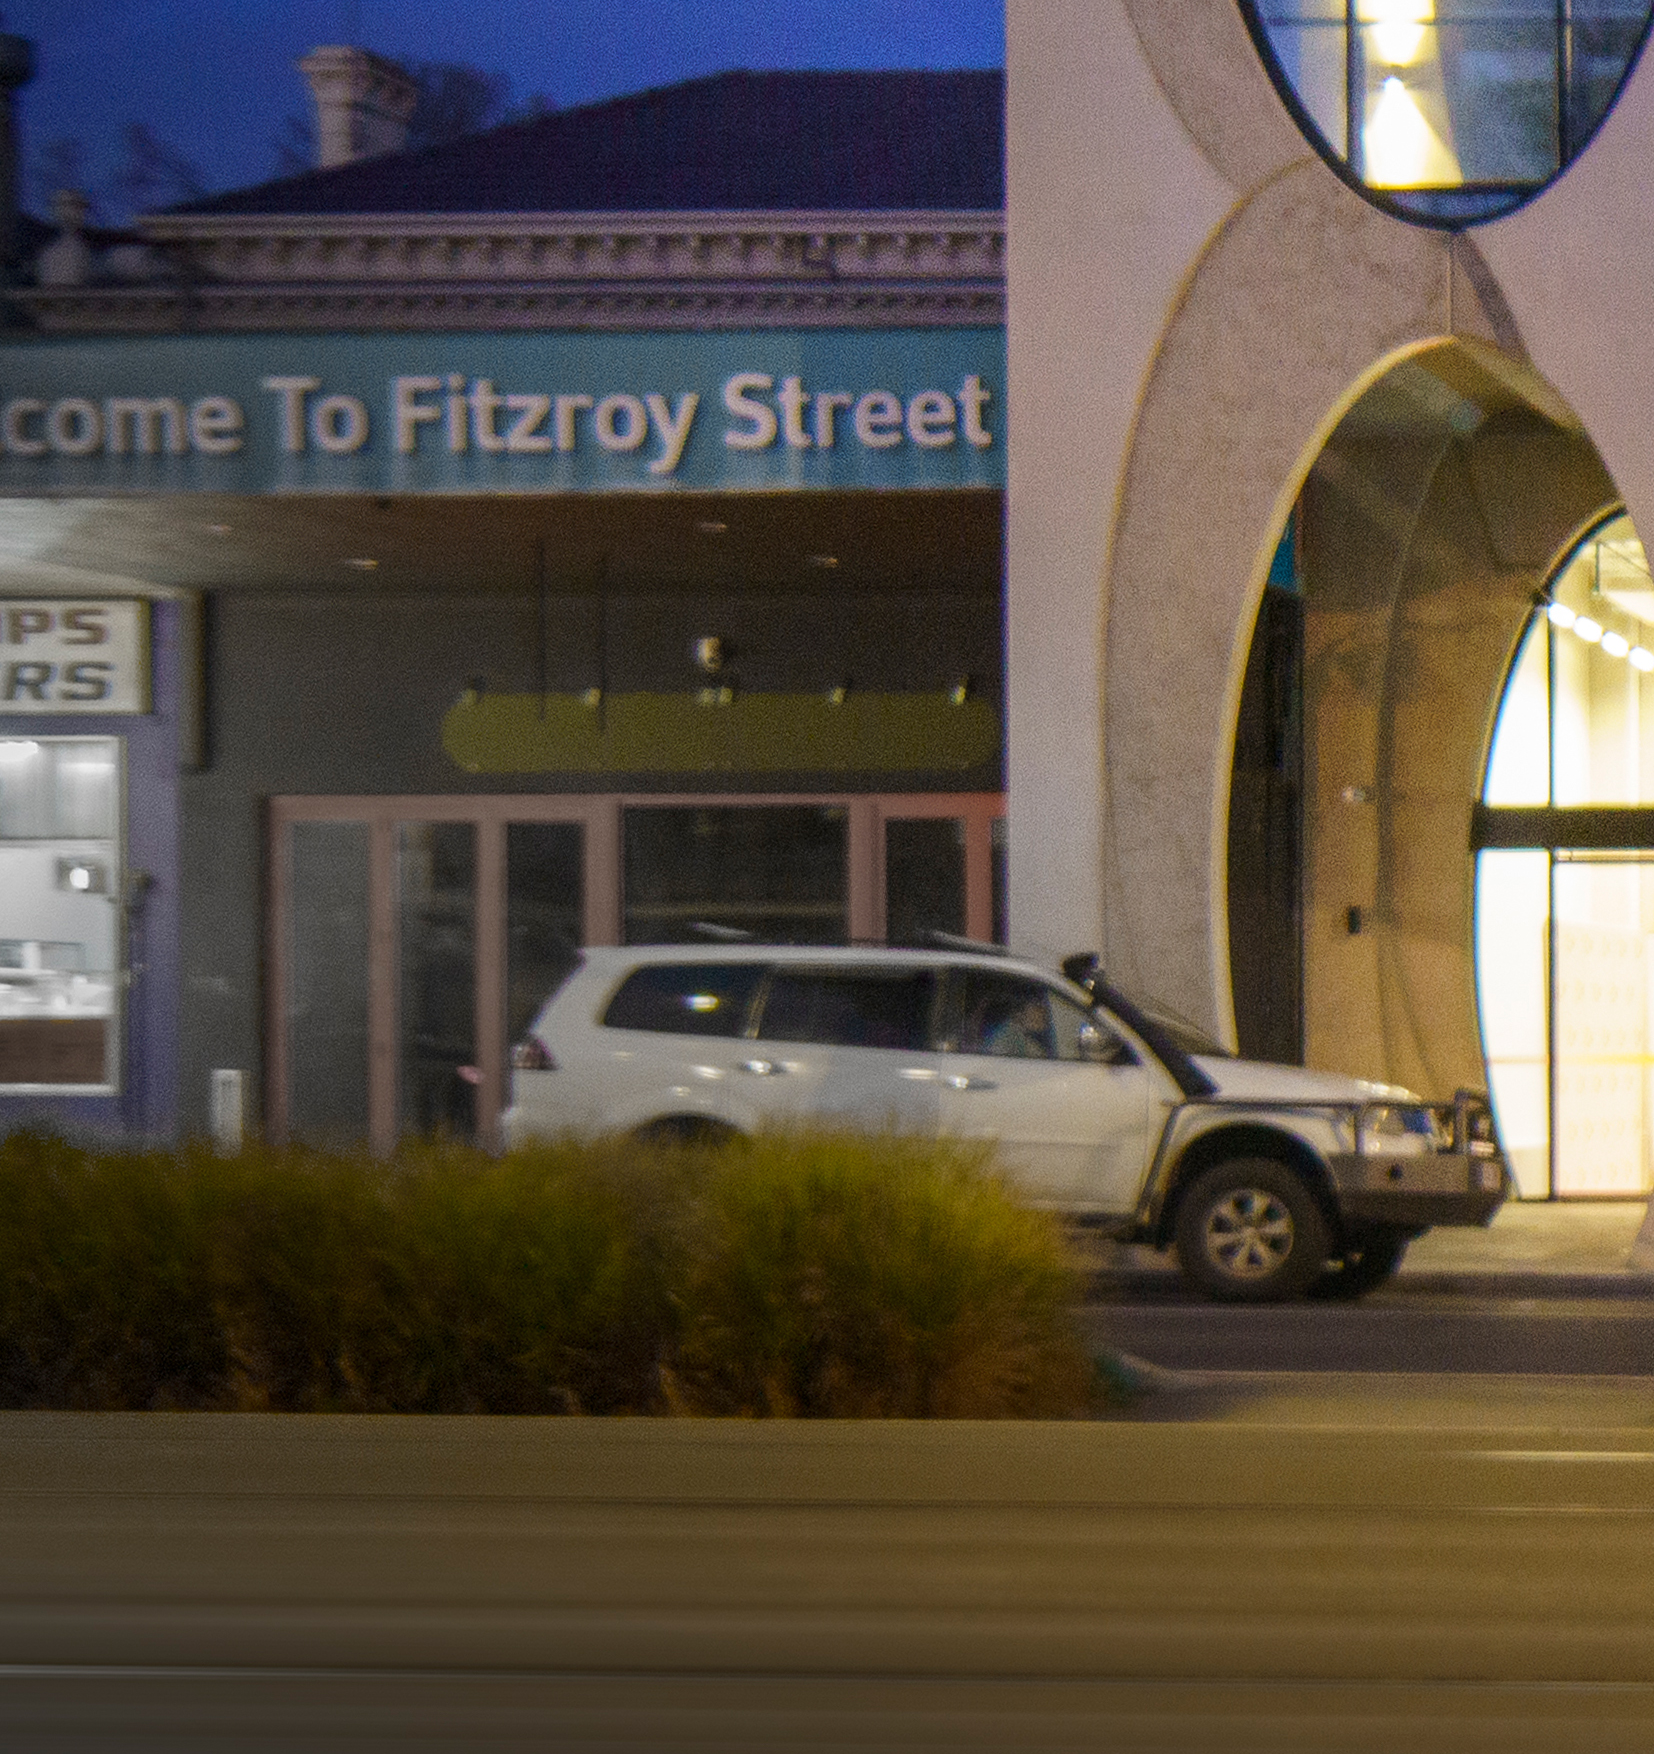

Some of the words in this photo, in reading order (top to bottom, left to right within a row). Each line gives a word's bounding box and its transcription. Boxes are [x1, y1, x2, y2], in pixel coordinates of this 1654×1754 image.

[2, 396, 245, 455] come
[259, 374, 369, 455] To
[394, 372, 699, 475] Fitzroy
[722, 371, 993, 449] Street
[0, 607, 109, 645] PS
[2, 659, 114, 701] RS
